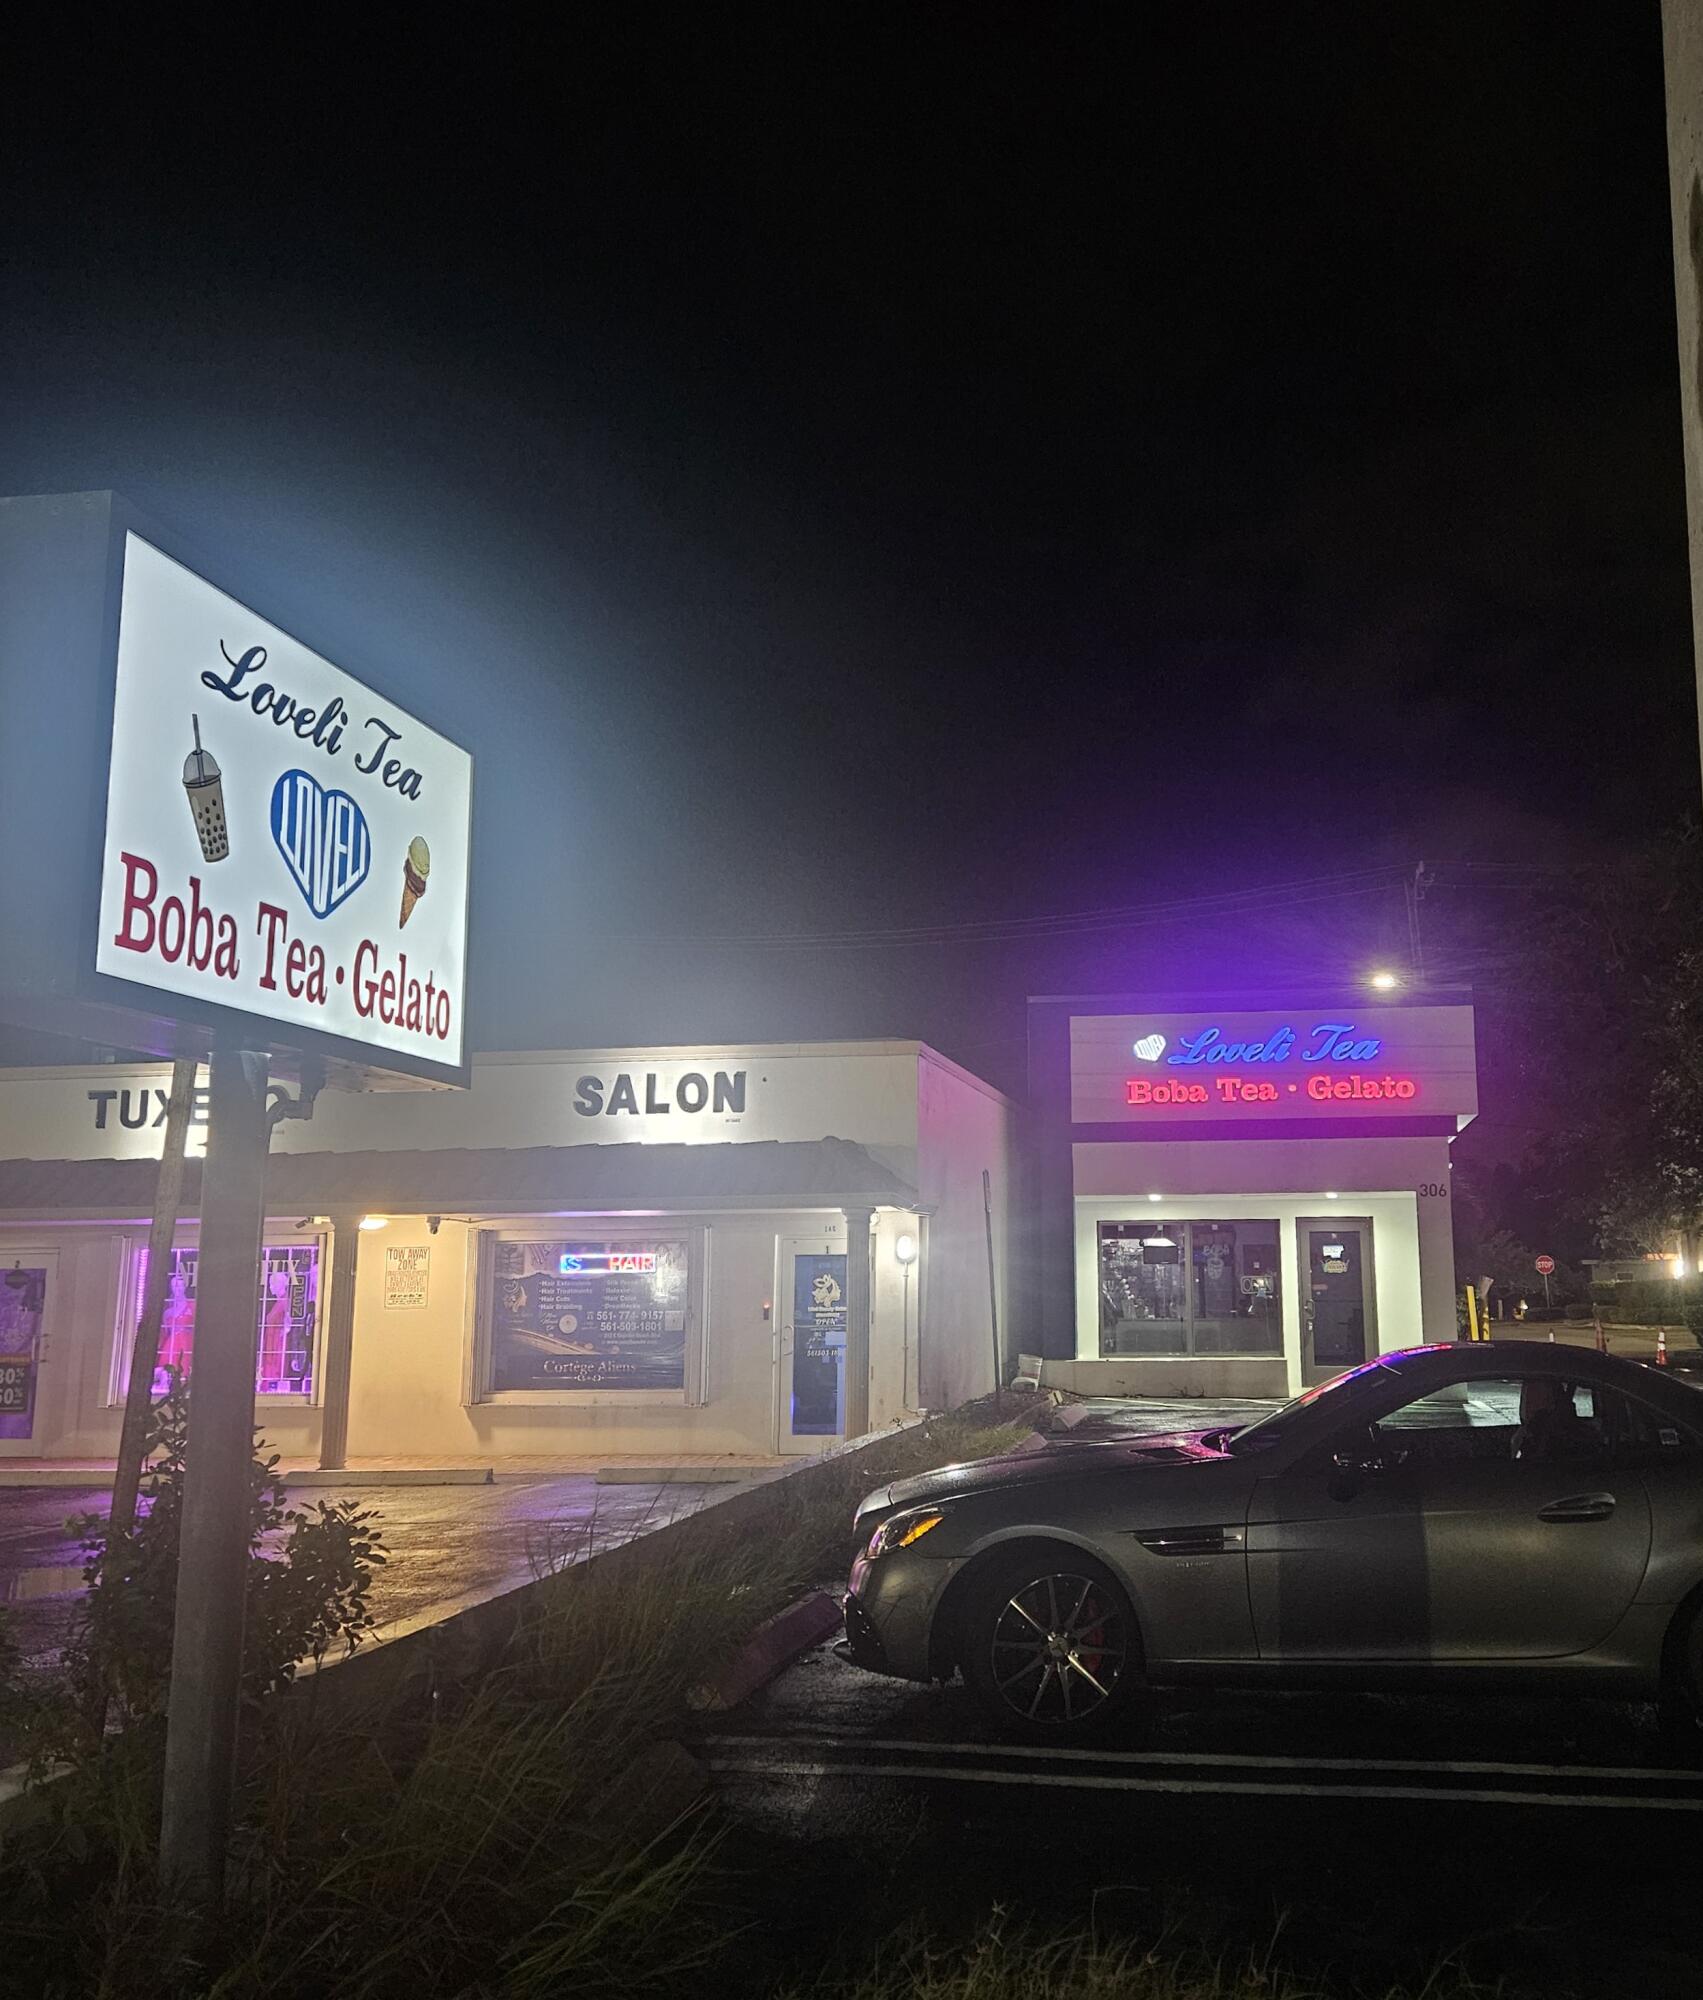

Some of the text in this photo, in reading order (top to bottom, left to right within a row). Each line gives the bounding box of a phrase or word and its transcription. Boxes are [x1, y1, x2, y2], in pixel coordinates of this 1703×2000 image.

[201, 638, 421, 800] Loveli Tea
[278, 774, 368, 914] LOVELI
[114, 851, 451, 1040] Boba Tea Gelato
[1168, 1024, 1382, 1065] Loveli Tea
[573, 1071, 747, 1117] SALON
[1126, 1074, 1415, 1104] Boba Tea Gelato
[88, 1085, 291, 1129] TUXE
[1419, 1183, 1447, 1197] 306
[389, 1248, 428, 1260] TOW AWAY
[397, 1260, 417, 1270] ZONE
[1537, 1261, 1553, 1269] STOP
[1243, 1277, 1275, 1293] OPN
[640, 1311, 664, 1321] 9157
